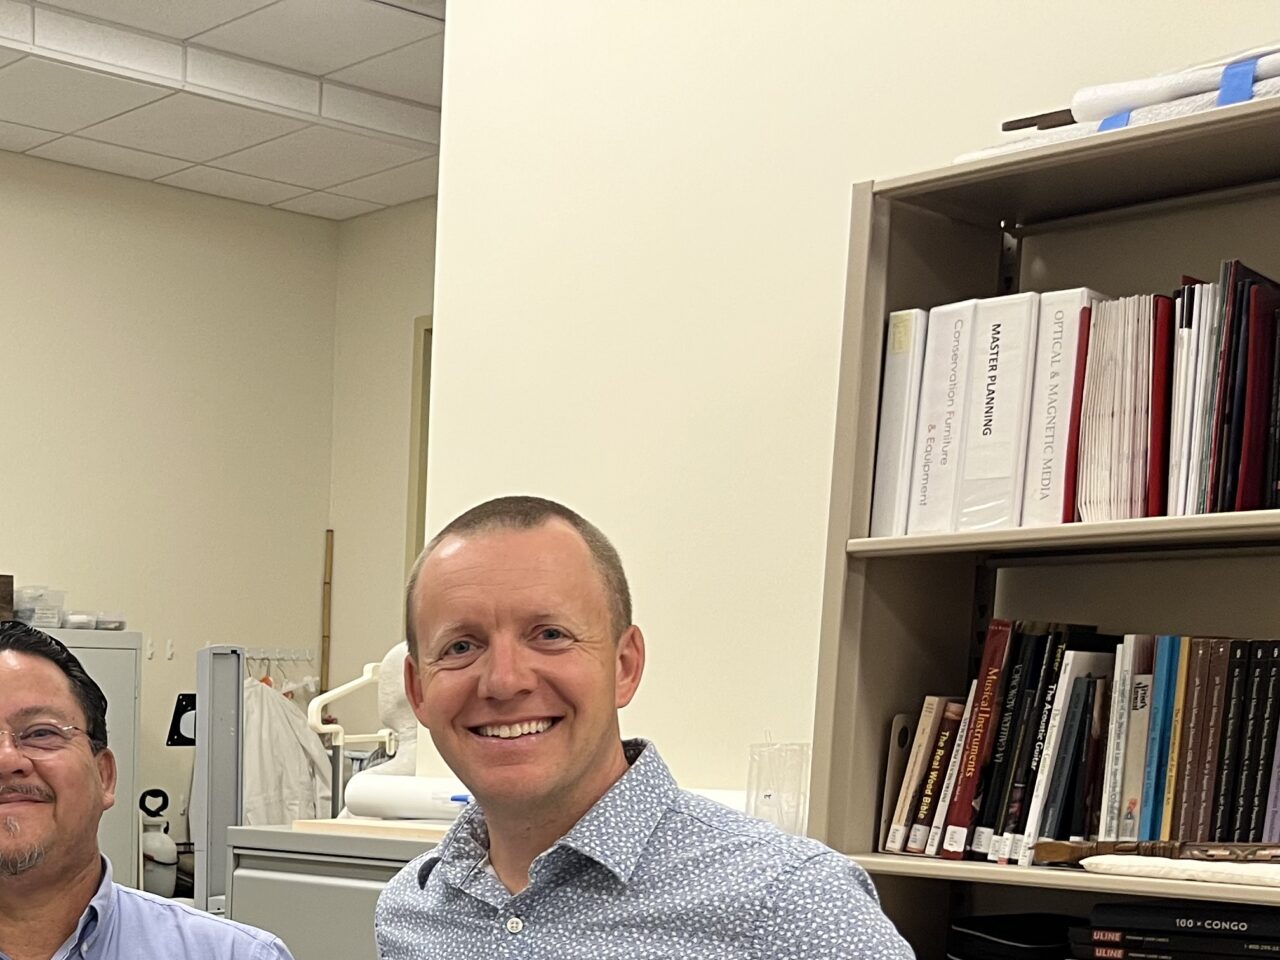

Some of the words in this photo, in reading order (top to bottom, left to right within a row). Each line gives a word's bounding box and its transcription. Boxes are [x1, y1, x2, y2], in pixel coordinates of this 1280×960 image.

[988, 324, 1001, 372] MASTER
[1050, 310, 1064, 367] OPTICAL
[947, 319, 963, 407] Conservation
[1050, 371, 1059, 380] &
[983, 375, 997, 436] PLANNING
[1044, 384, 1058, 454] MAGNETIC
[927, 424, 936, 433] &
[940, 411, 955, 466] Furniture
[919, 437, 936, 506] Equipment
[1039, 458, 1052, 502] MEDIA
[1053, 643, 1066, 672] Teeter
[979, 666, 1000, 710] Musical
[1045, 683, 1056, 701] The
[1036, 703, 1052, 740] Acoustic
[937, 730, 950, 747] The
[965, 712, 991, 777] Instruments
[931, 749, 945, 769] Real
[1030, 741, 1043, 771] Guitar
[924, 770, 940, 794] Wood
[918, 796, 933, 819] Bible
[1093, 930, 1121, 942] ULINE
[1175, 918, 1194, 928] 100
[1204, 920, 1248, 931] CONGO
[1095, 947, 1123, 959] ULINE
